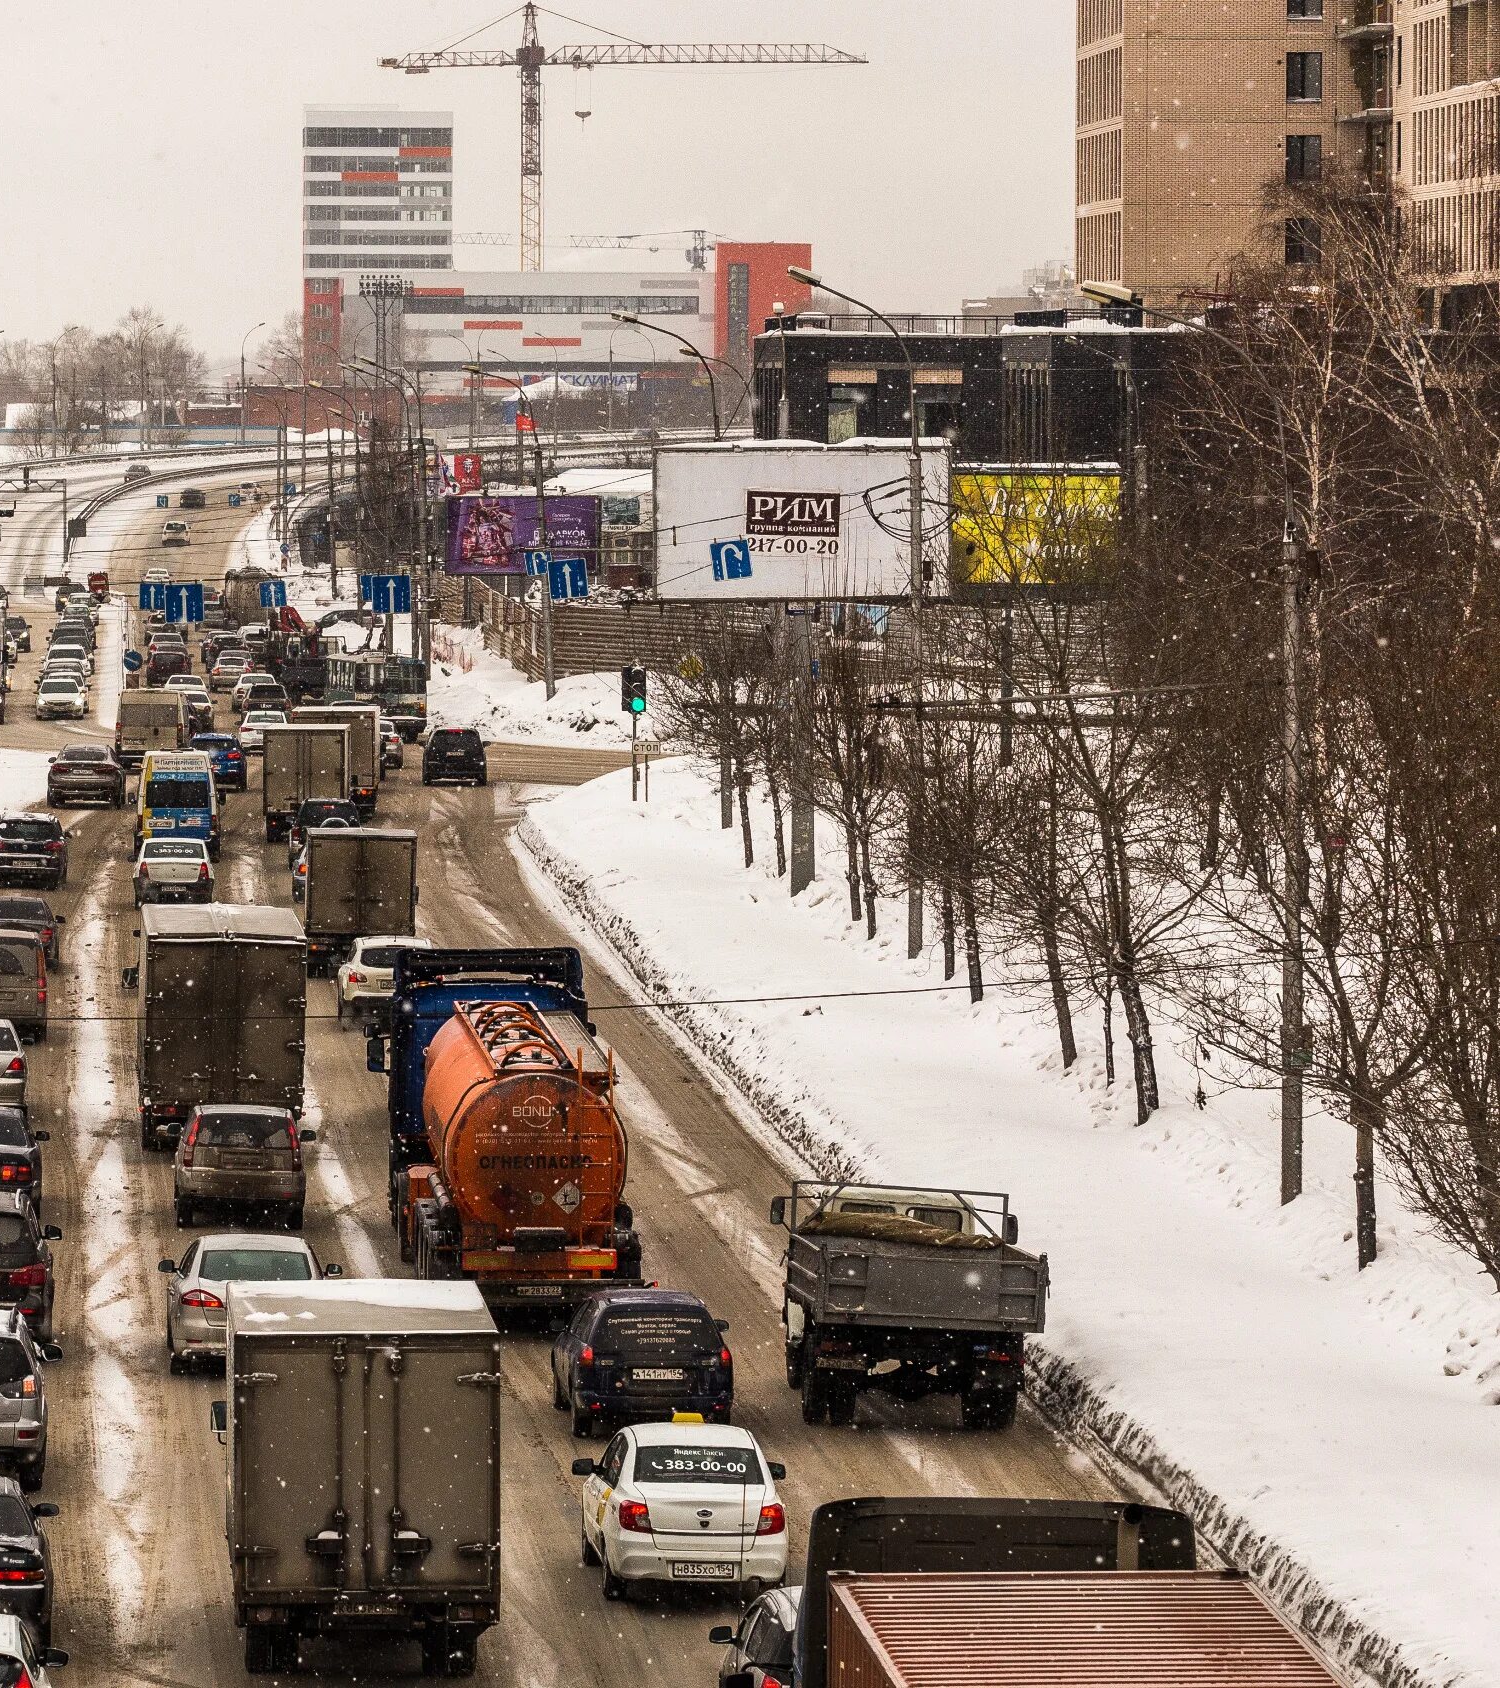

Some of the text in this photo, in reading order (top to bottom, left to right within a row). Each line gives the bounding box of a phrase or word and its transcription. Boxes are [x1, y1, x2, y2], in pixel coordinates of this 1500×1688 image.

[751, 496, 835, 522] РИМ
[750, 524, 836, 533] группа компаний
[747, 537, 839, 554] 217-00-20
[480, 1155, 593, 1169] ОГНЕОПАСНО
[674, 1448, 701, 1456] Яндекс
[664, 1460, 747, 1473] 383-00-00
[676, 1564, 714, 1575] Н835ХО
